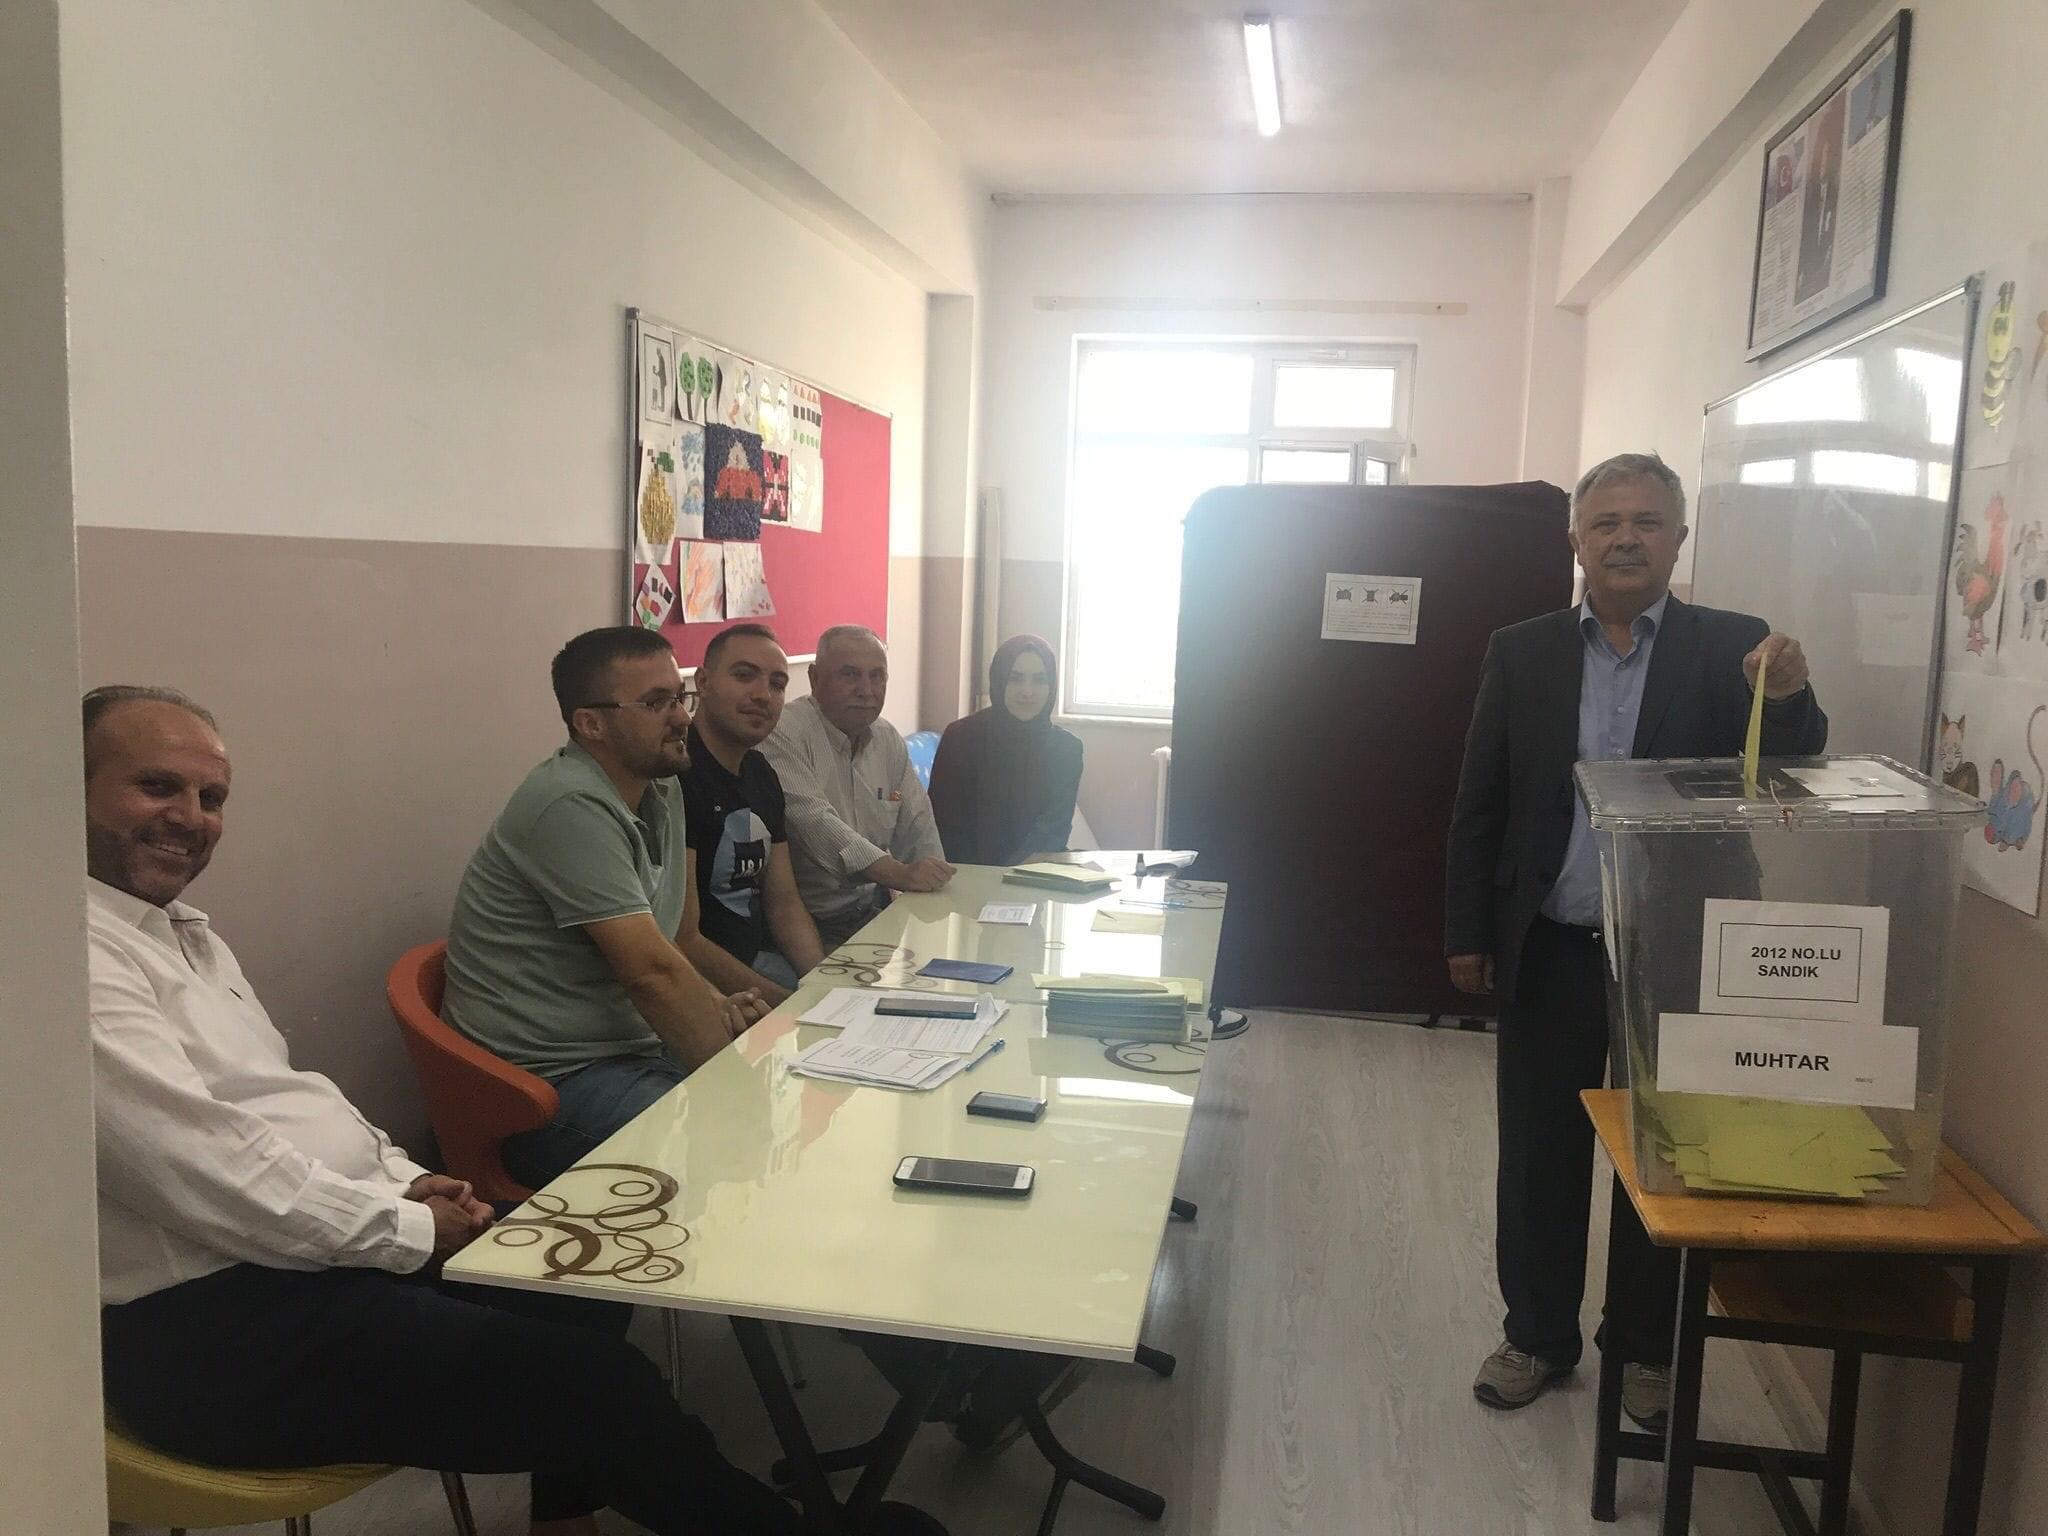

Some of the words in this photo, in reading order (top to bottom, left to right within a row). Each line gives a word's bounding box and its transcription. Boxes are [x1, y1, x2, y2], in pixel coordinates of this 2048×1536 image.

[1751, 947, 1786, 959] 2012
[1791, 948, 1841, 960] NO.LU
[1758, 965, 1819, 978] SANDIK
[1735, 1051, 1830, 1071] MUHTAR
